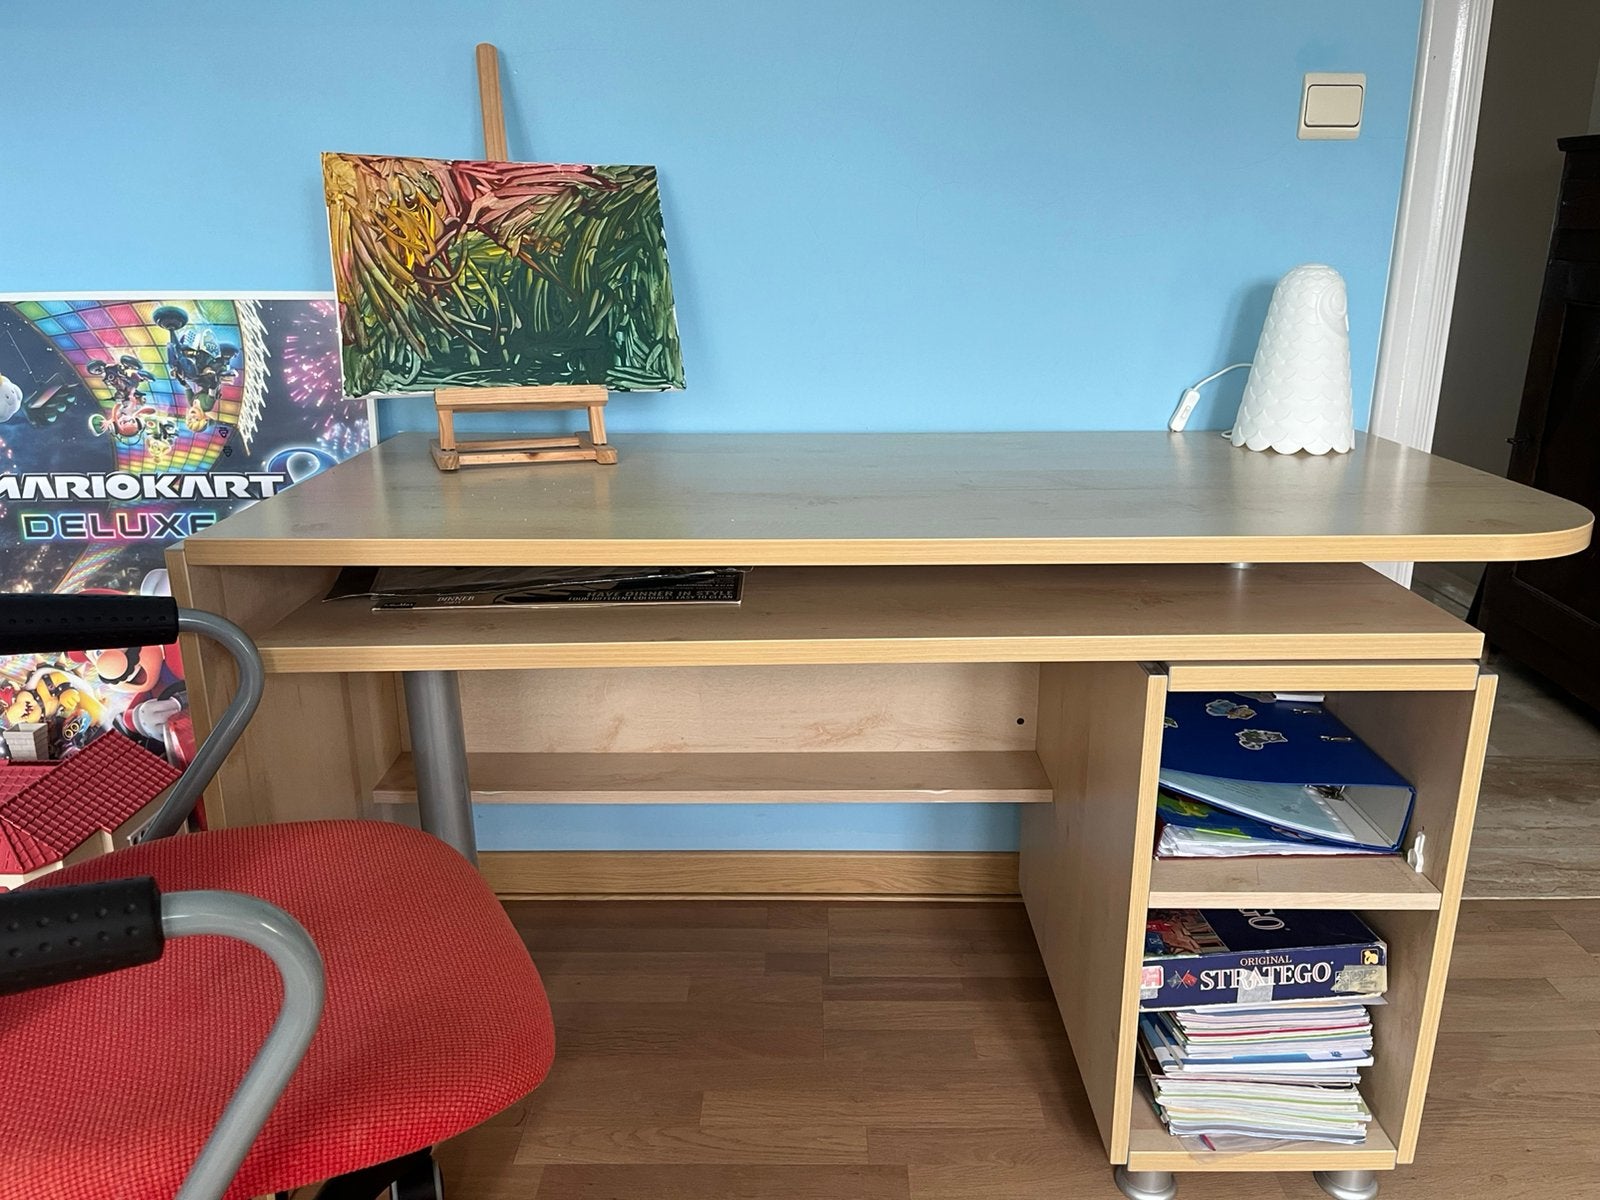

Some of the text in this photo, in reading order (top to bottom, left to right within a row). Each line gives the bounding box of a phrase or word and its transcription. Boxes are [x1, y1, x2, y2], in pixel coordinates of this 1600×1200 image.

[21, 512, 217, 539] DELUXE
[1240, 955, 1292, 966] ORIGINAL
[1200, 961, 1332, 990] STRATEGO
